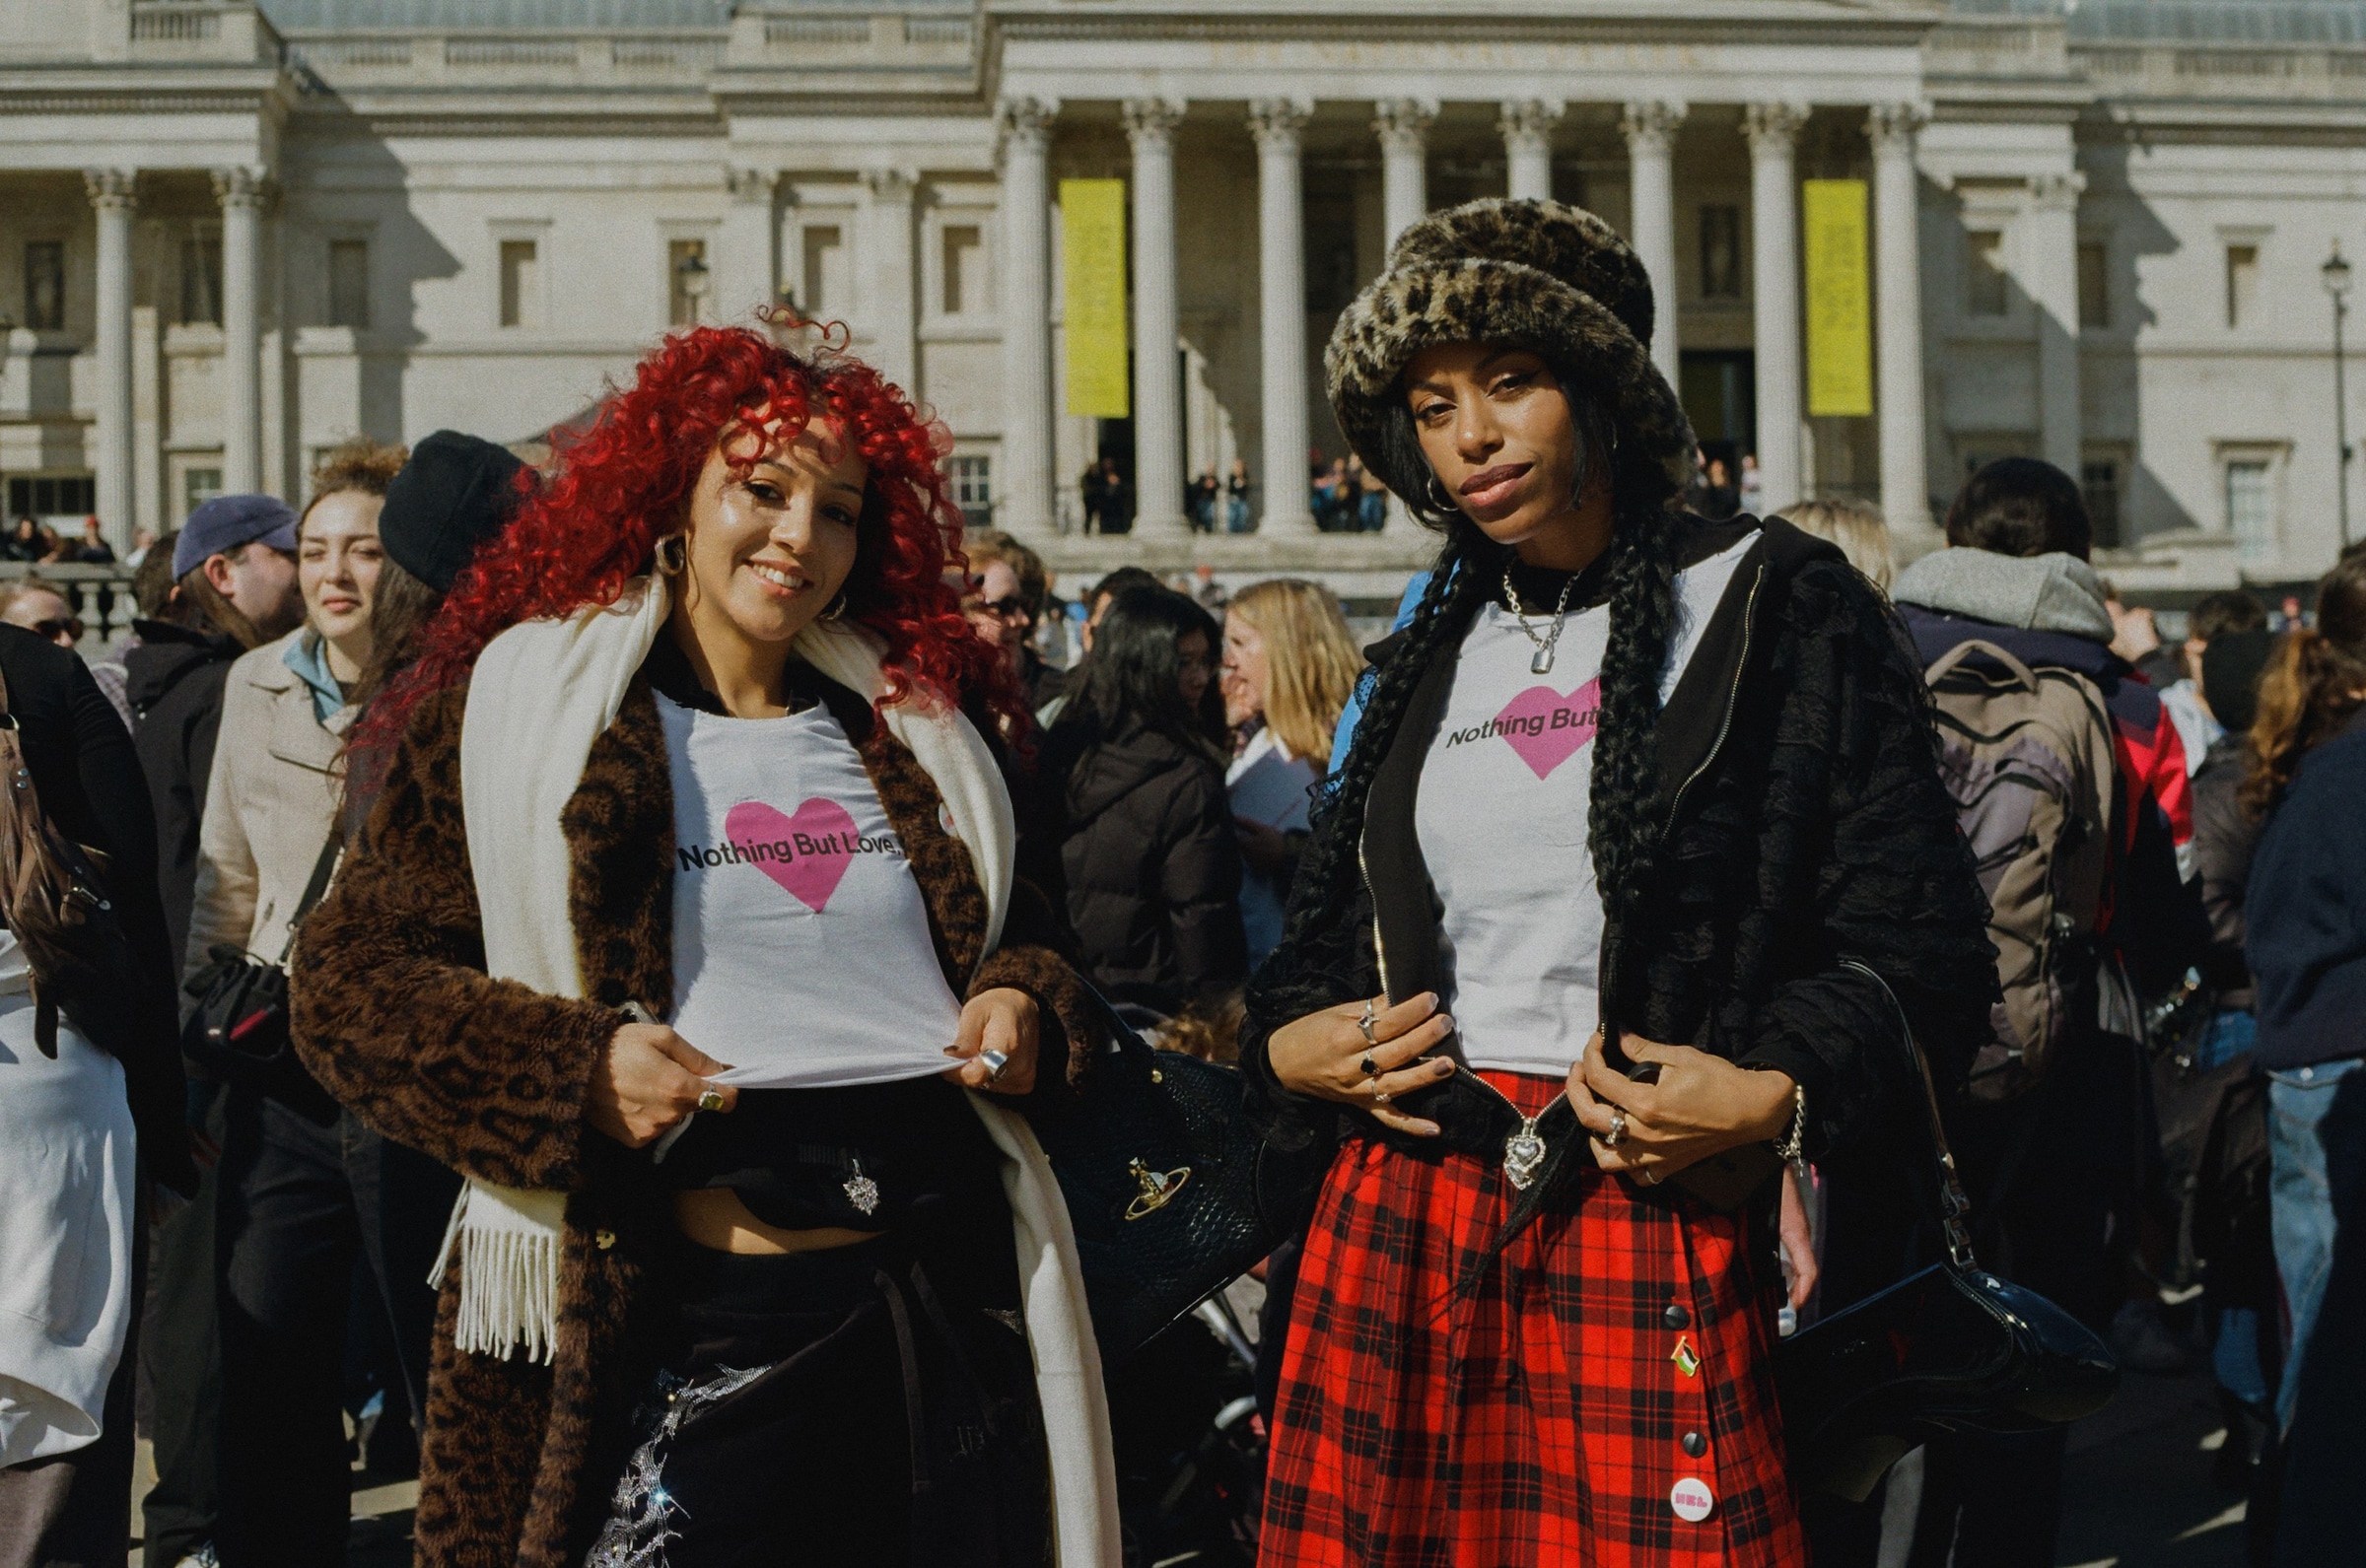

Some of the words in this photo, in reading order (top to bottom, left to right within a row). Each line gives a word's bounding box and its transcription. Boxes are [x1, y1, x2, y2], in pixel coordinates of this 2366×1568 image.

[1445, 715, 1546, 749] Nothing
[1550, 707, 1599, 729] But
[677, 839, 794, 872] Nothing
[793, 833, 841, 856] But
[842, 832, 901, 856] Love,
